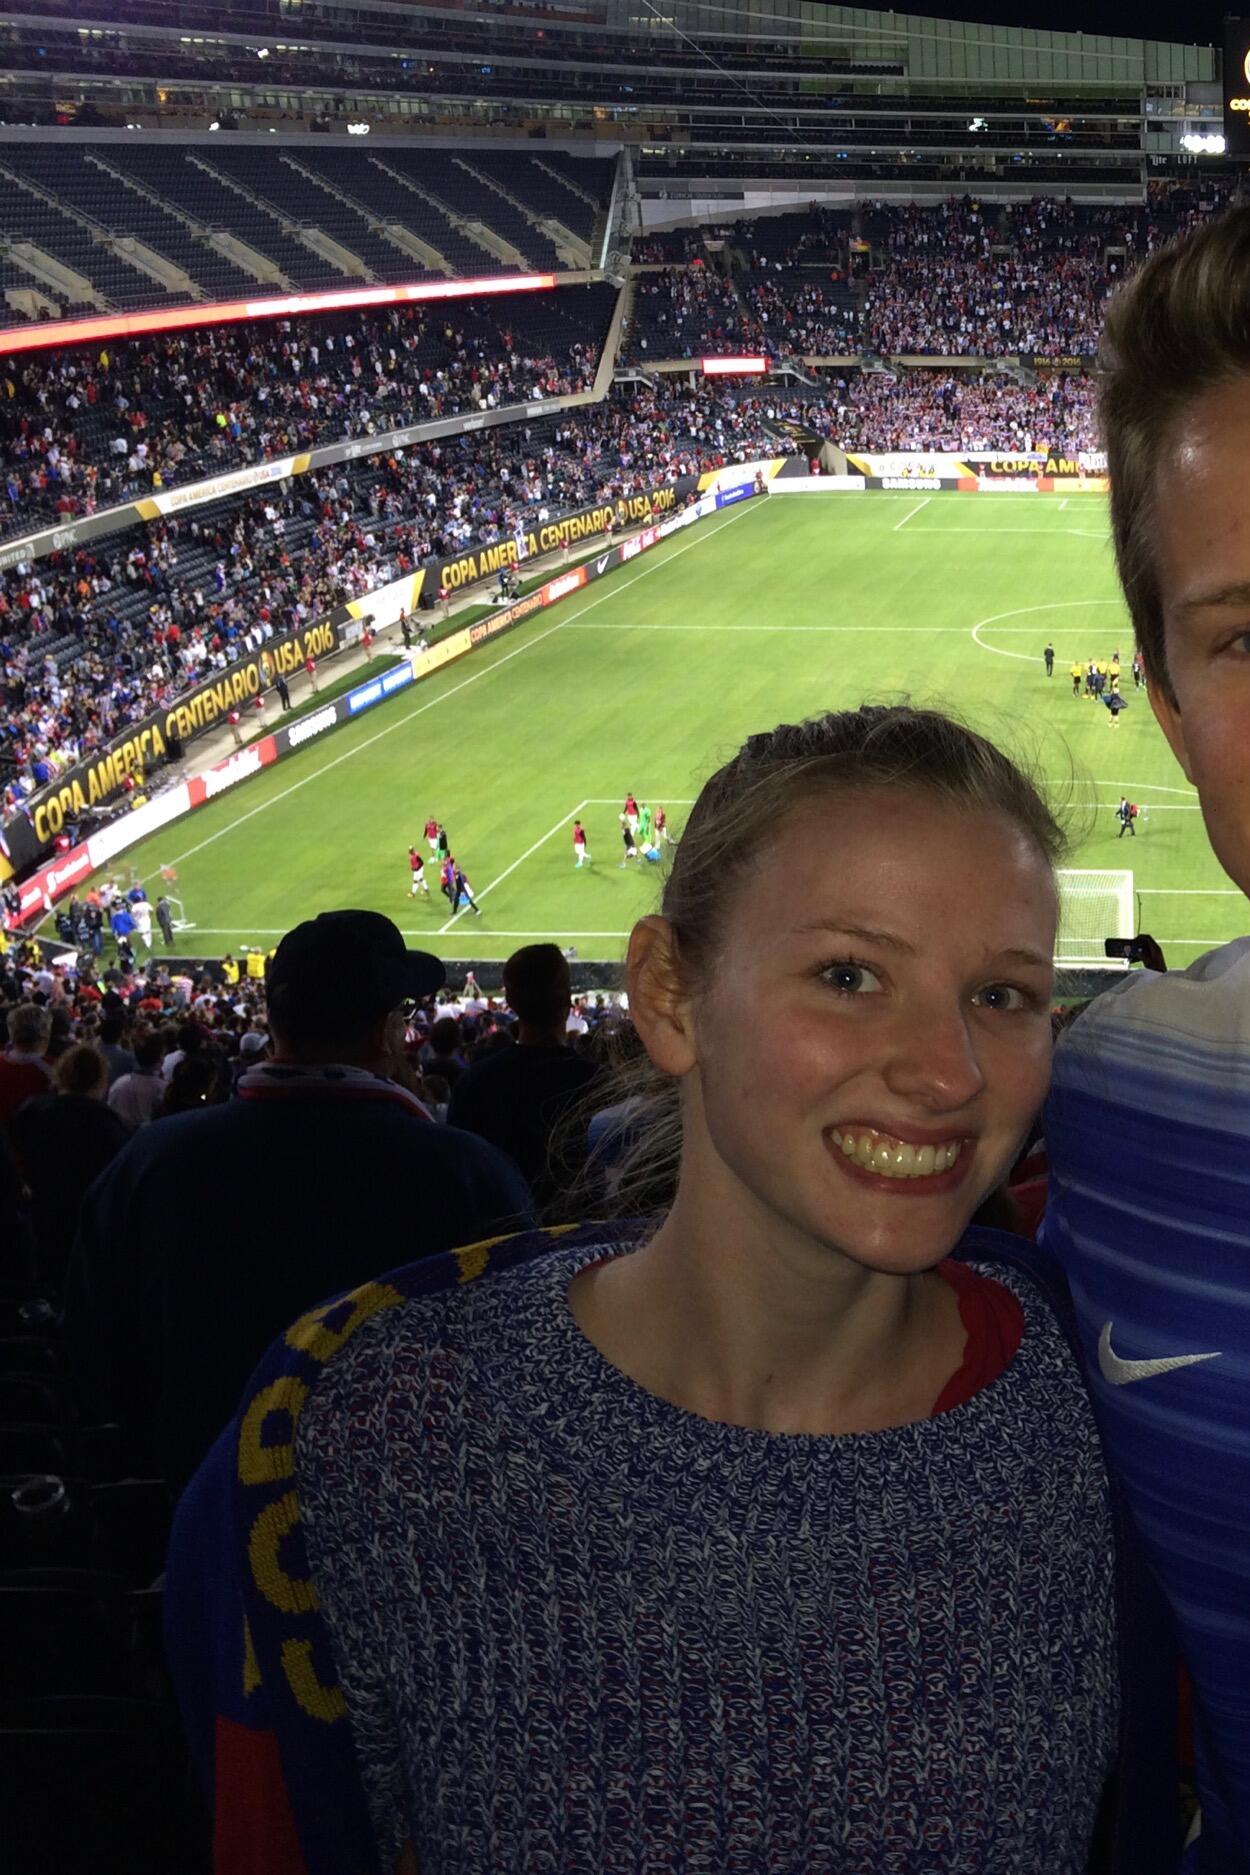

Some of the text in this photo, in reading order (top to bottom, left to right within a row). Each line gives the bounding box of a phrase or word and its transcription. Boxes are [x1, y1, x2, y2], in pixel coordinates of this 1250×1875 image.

[1177, 154, 1199, 165] LOFT
[441, 561, 477, 590] COPA
[540, 508, 614, 551] CENTENARIO
[628, 495, 651, 519] USA
[652, 487, 676, 511] 2016
[34, 780, 86, 843] COPA
[166, 664, 260, 739] CENTENARIO
[274, 638, 305, 675] USA
[304, 621, 334, 658] 2016
